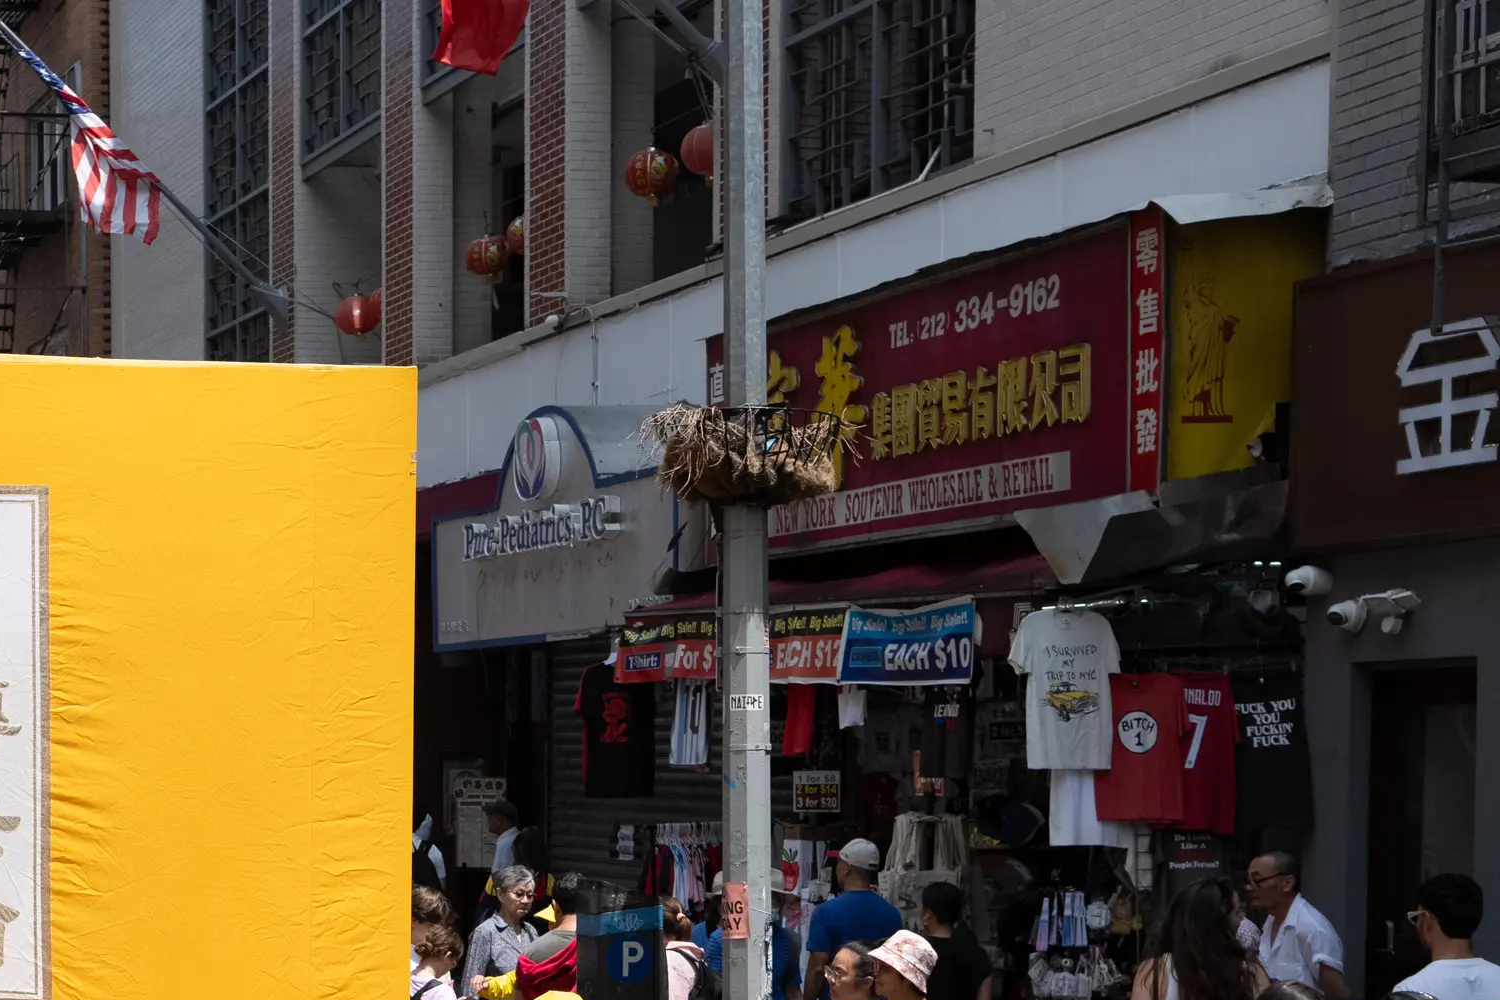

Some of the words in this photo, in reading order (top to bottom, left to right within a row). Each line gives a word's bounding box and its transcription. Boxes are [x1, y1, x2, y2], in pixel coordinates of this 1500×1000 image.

[888, 322, 914, 349] TEL:
[916, 311, 950, 340] (212)
[954, 273, 1060, 333] 334-9162
[1135, 228, 1159, 455] 零售批發
[871, 342, 1091, 460] 集團貿易有限公司
[1395, 316, 1500, 475] 金
[776, 504, 799, 534] NEW
[803, 496, 836, 529] YORK
[845, 479, 903, 523] SOUVENIR
[907, 468, 983, 512] WHOLESALE
[987, 465, 998, 498] &
[1002, 457, 1054, 497] RETAIL
[464, 524, 496, 561] Pure
[579, 498, 608, 540] PC
[661, 624, 675, 638] Big
[700, 622, 714, 636] Big
[810, 615, 822, 631] Big
[673, 643, 699, 670] For
[776, 640, 812, 670] EACH
[884, 642, 931, 672] EACH
[934, 637, 971, 672] $10
[1052, 644, 1097, 657] SURVIVED
[1062, 659, 1075, 669] MY
[1045, 671, 1065, 681] TRIP
[1066, 671, 1076, 680] TO
[1080, 669, 1097, 680] NYC
[1235, 702, 1266, 715] FUCK
[1270, 699, 1297, 712] YOU
[1121, 717, 1155, 734] BITCH
[1252, 712, 1280, 725] YOU
[1246, 722, 1294, 738] FUCKIN'
[1134, 731, 1144, 747] 1
[1184, 713, 1208, 769] 7
[1252, 734, 1290, 748] FUCK
[807, 774, 820, 783] for
[805, 784, 817, 794] for
[820, 784, 837, 794] $14
[797, 797, 804, 808] 3
[805, 797, 818, 808] for
[820, 797, 837, 808] $20
[622, 941, 644, 977] P
